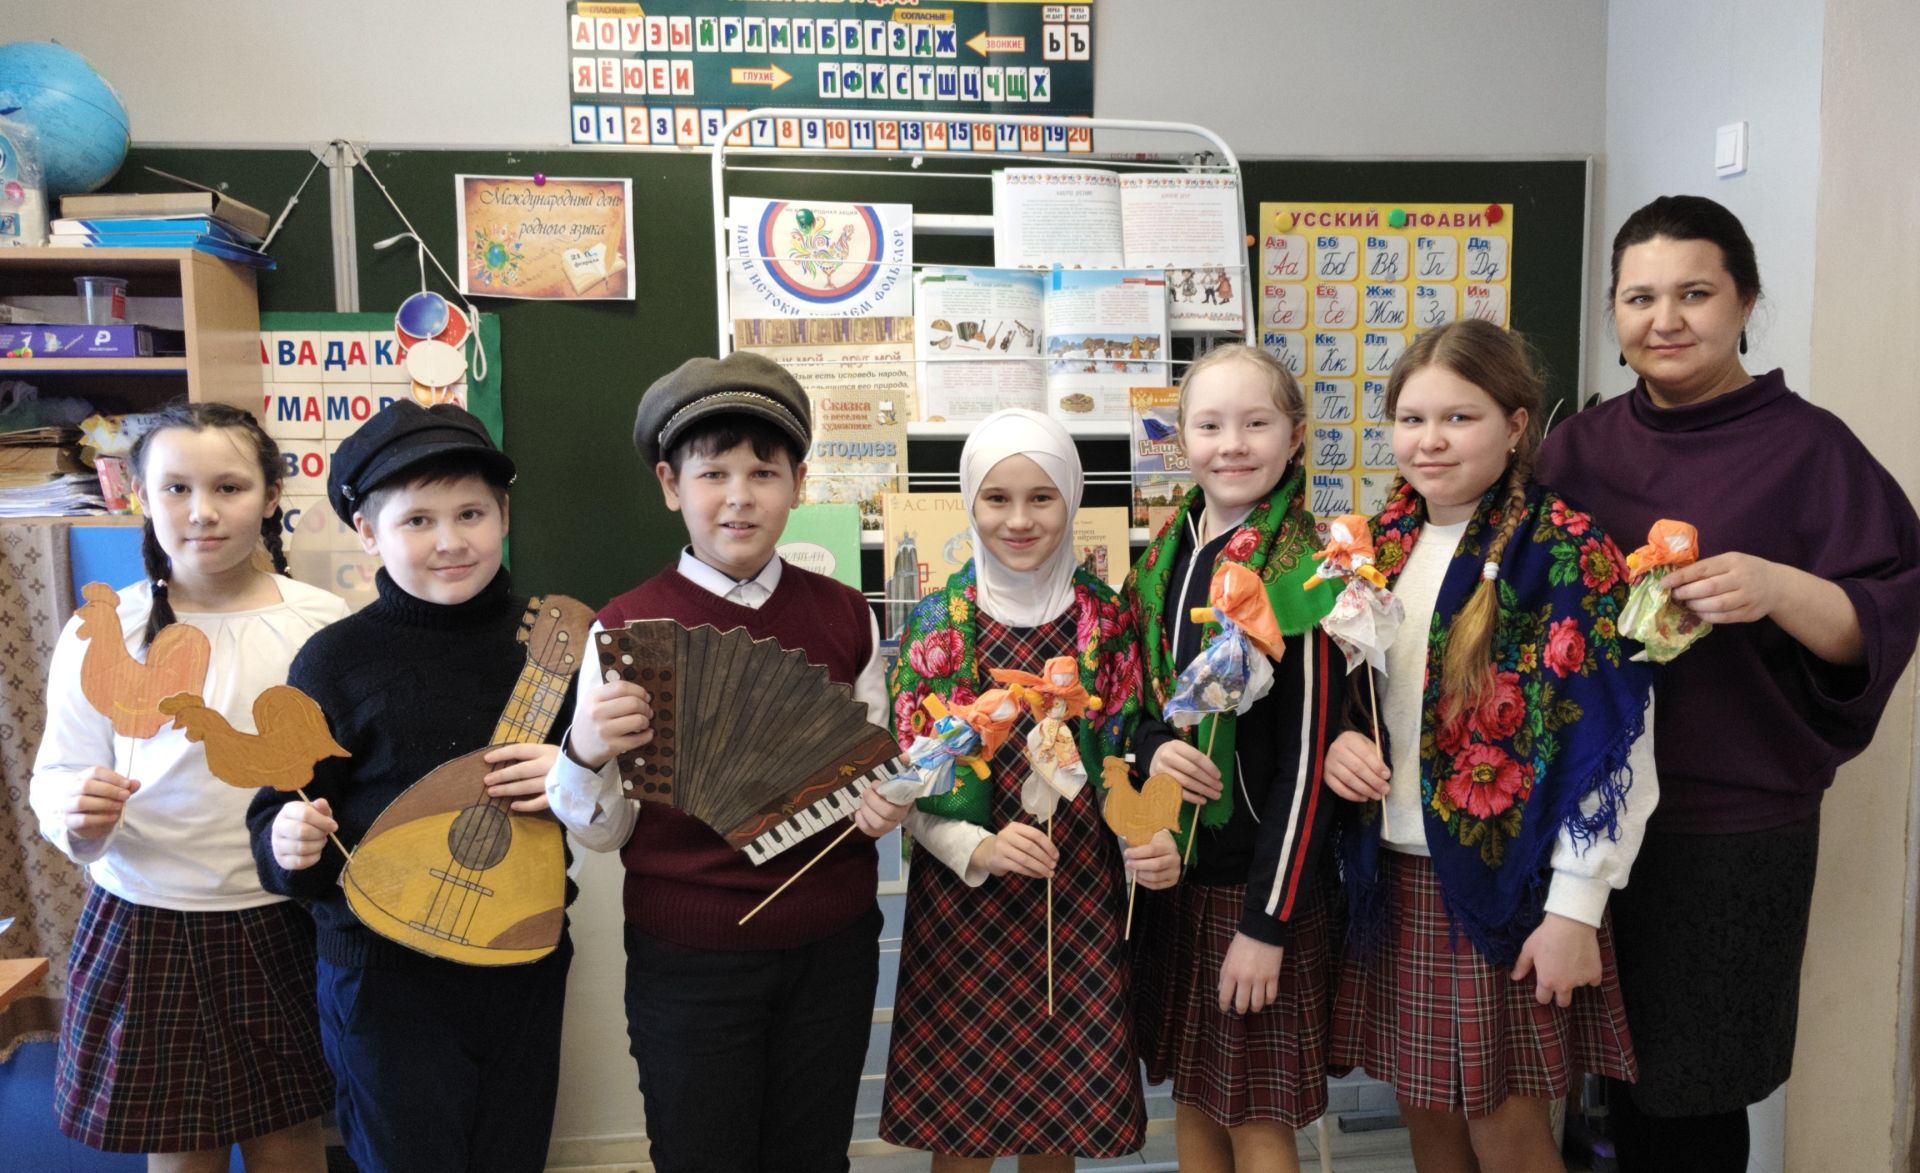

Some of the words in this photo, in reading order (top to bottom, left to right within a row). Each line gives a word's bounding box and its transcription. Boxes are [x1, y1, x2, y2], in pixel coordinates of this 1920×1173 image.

[901, 12, 946, 21] СОГЛАСНЫЕ
[576, 22, 590, 43] А
[602, 23, 614, 43] О
[627, 23, 641, 44] У
[651, 24, 662, 44] Э
[671, 23, 690, 46] Ы
[700, 19, 714, 46] Й
[724, 24, 738, 46] Р
[747, 24, 762, 47] Л
[771, 25, 788, 47] М
[798, 26, 811, 47] Н
[822, 26, 835, 48] Б
[845, 26, 859, 49] В
[871, 28, 883, 50] Г
[893, 28, 906, 50] З
[915, 29, 932, 55] Д
[936, 30, 956, 53] Ж
[986, 39, 1023, 49] ЗВОНКИЕ
[578, 66, 591, 87] Я
[602, 61, 614, 88] Ё
[624, 66, 643, 88] Ю
[653, 68, 664, 88] Е
[676, 68, 690, 89] И
[743, 72, 775, 82] ГЛУХИЕ
[823, 71, 836, 93] П
[843, 70, 863, 92] Ф
[871, 72, 885, 93] К
[896, 73, 908, 94] С
[919, 73, 931, 95] Т
[938, 74, 957, 95] Ш
[964, 74, 978, 98] Ц
[987, 75, 1000, 96] Ч
[1007, 75, 1026, 99] Щ
[1034, 75, 1047, 97] Х
[579, 116, 590, 134] 0
[606, 116, 614, 134] 1
[631, 117, 642, 134] 2
[657, 118, 668, 135] 3
[682, 118, 693, 136] 4
[708, 118, 718, 136] 5
[757, 119, 768, 137] 7
[782, 121, 792, 138] 8
[807, 121, 817, 139] 9
[827, 122, 845, 139] 10
[854, 122, 870, 139] 11
[878, 123, 896, 140] 12
[902, 123, 920, 140] 13
[926, 123, 945, 140] 14
[951, 124, 968, 140] 15
[974, 124, 992, 141] 16
[999, 125, 1016, 141] 17
[1022, 126, 1039, 141] 18
[1046, 126, 1063, 141] 19
[1069, 127, 1088, 142] 20
[480, 187, 593, 211] Международный
[597, 189, 623, 207] день
[519, 217, 566, 239] родного
[570, 223, 606, 241] языка
[1276, 209, 1379, 227] УССКИЙ
[1389, 213, 1495, 227] ЛФАВИ
[278, 340, 318, 366] ВА
[324, 340, 367, 371] ДА
[278, 396, 322, 422] МА
[327, 395, 371, 421] МО
[821, 399, 871, 411] Сказка
[806, 441, 896, 461] стодиев
[1139, 440, 1183, 456] Наша
[934, 499, 967, 512] ПУШ
